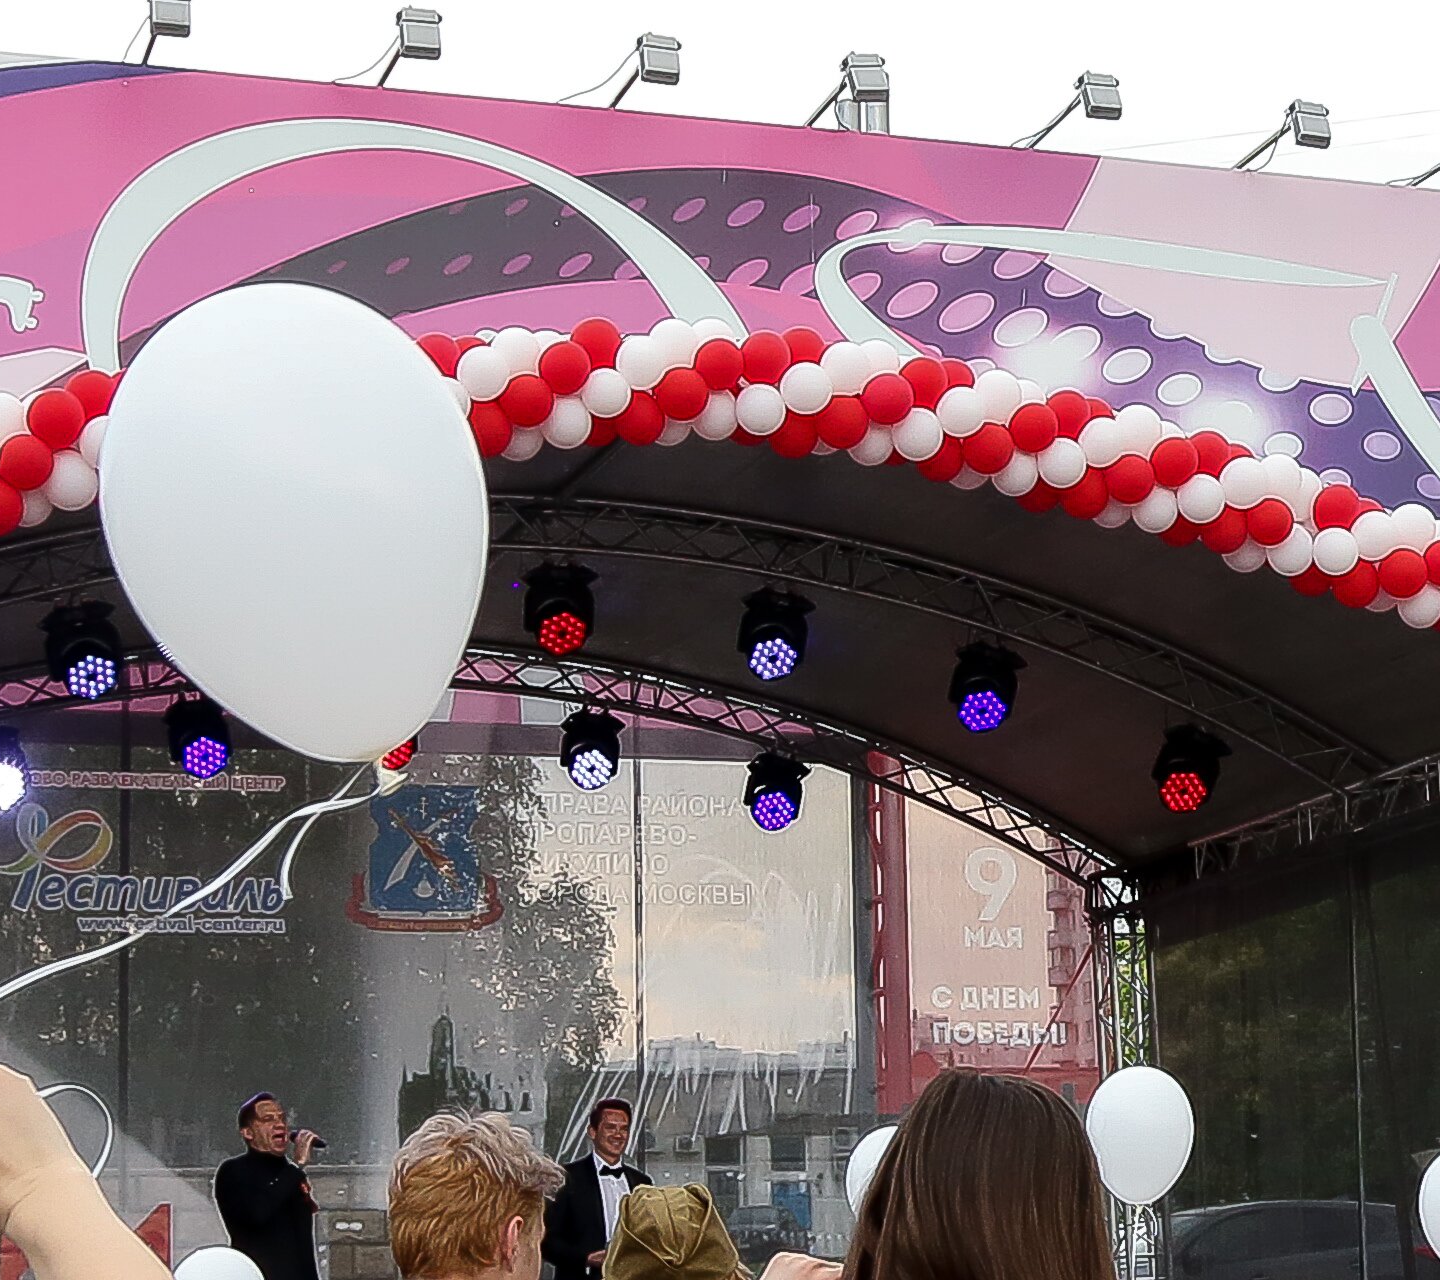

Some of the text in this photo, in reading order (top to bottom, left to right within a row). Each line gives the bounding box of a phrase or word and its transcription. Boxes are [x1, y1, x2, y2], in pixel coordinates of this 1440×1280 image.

[231, 775, 286, 792] ЦЕНТР
[964, 846, 1018, 922] 9
[963, 925, 1024, 949] МАЯ
[931, 984, 1040, 1011] С ДНЕМ
[931, 1020, 1068, 1047] ПОБЕДЫ!
